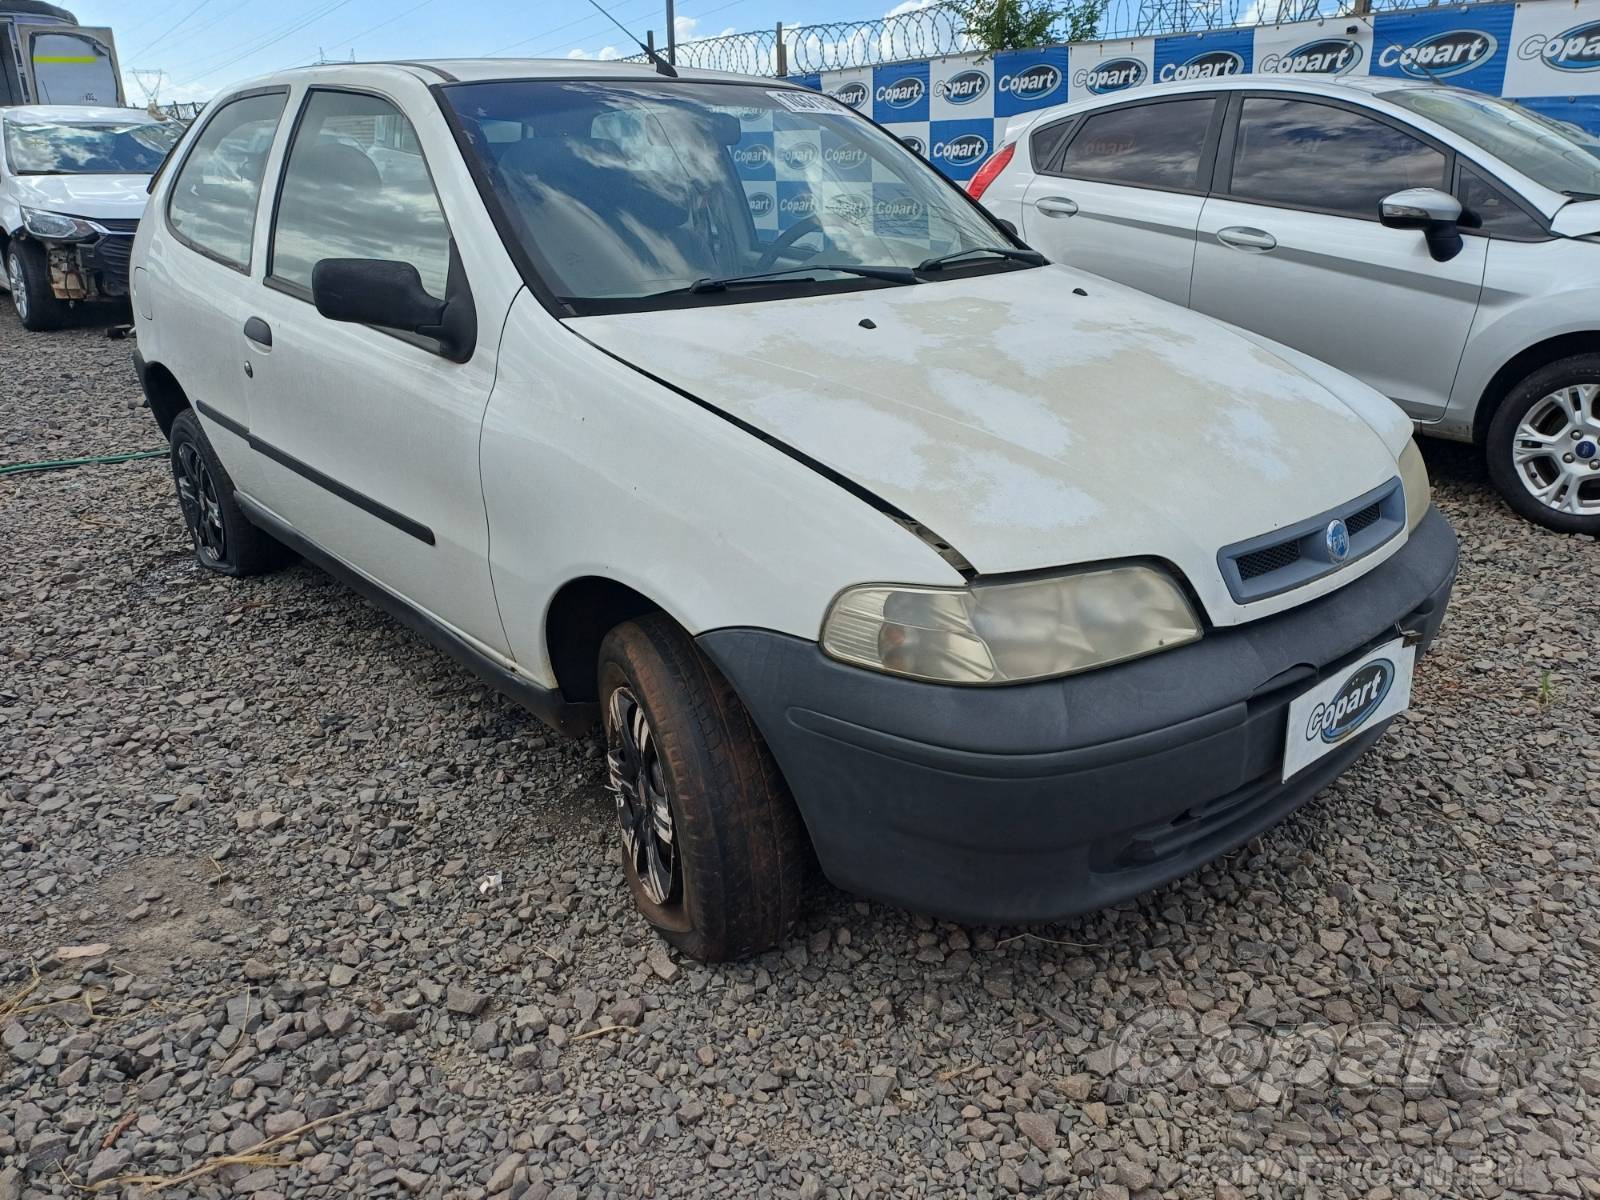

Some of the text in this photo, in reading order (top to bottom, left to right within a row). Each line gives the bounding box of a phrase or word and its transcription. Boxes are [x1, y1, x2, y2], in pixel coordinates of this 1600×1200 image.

[1379, 37, 1483, 69] Copart
[1517, 32, 1600, 62] Copa
[1159, 57, 1233, 81] Copart
[1259, 47, 1348, 74] Copart
[934, 75, 983, 99] Copart
[998, 70, 1054, 94] Copart
[1073, 65, 1137, 89] Copart
[876, 83, 920, 102] Copart
[825, 147, 862, 163] Copart
[933, 139, 983, 160] Copart
[1306, 669, 1382, 740] Copart
